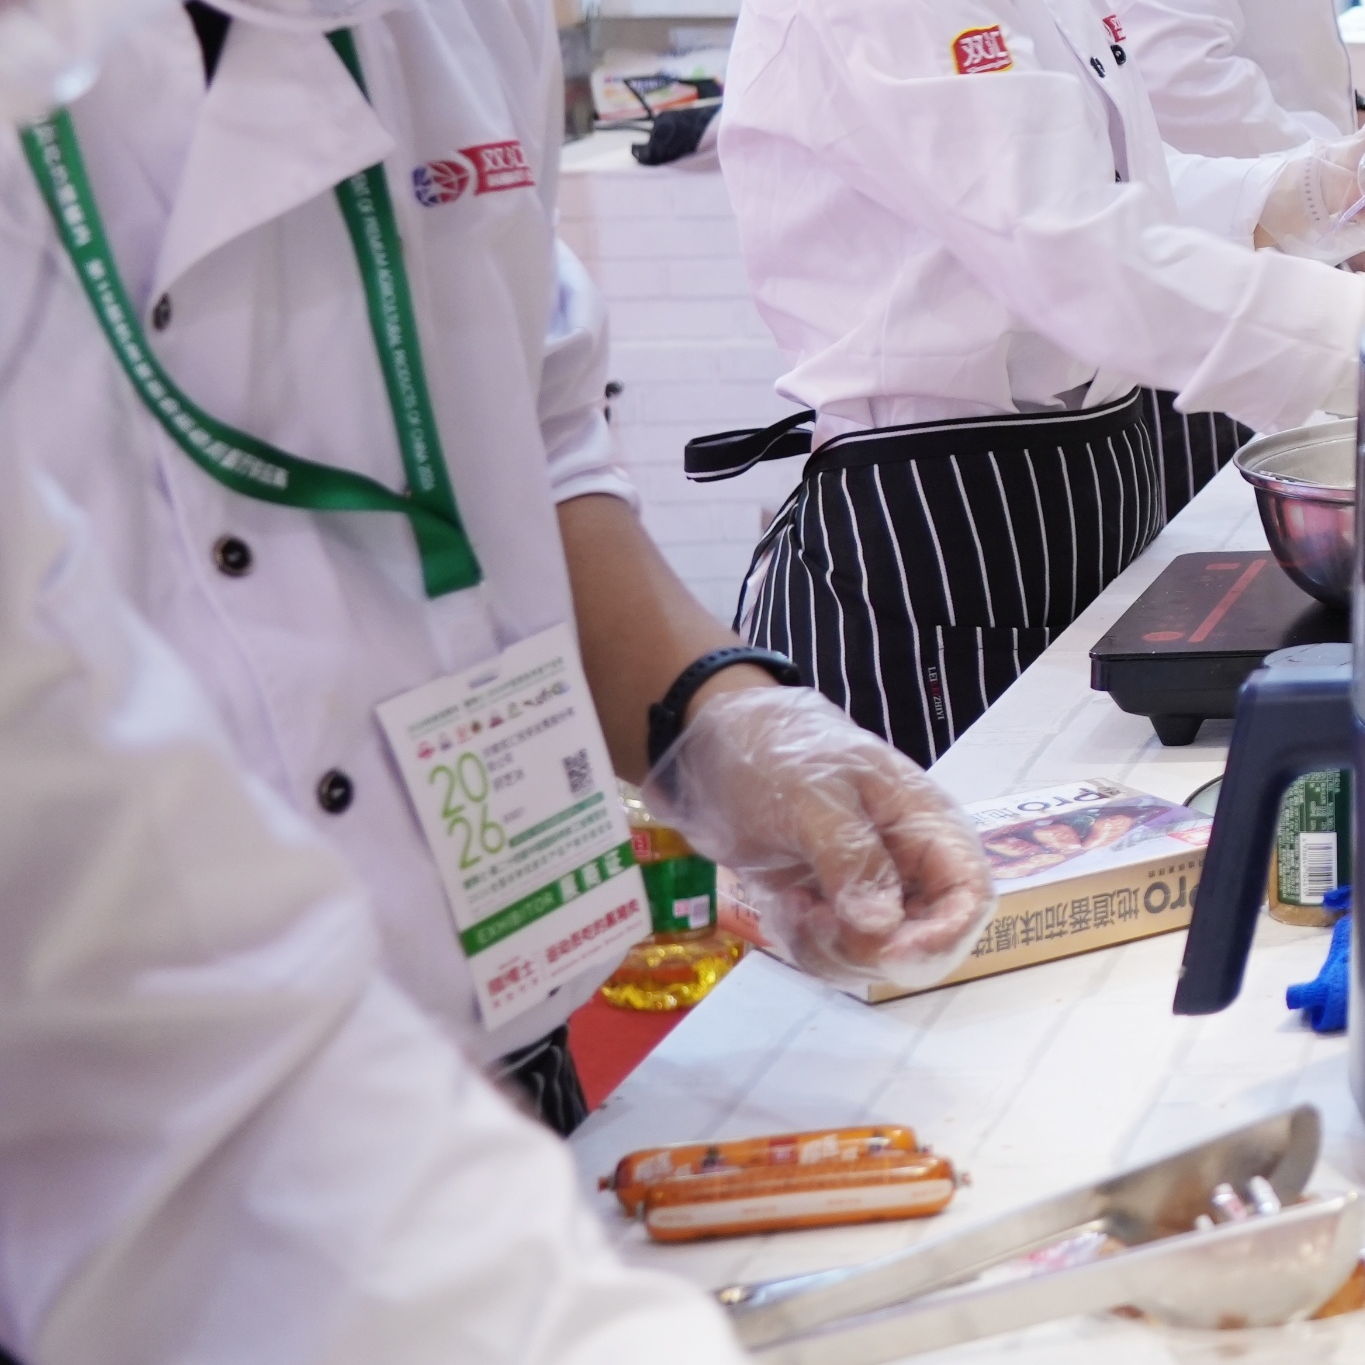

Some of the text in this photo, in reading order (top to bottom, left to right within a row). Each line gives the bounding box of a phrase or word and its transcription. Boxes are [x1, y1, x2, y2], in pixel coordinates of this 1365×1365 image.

[959, 31, 1008, 67] 双汇
[427, 750, 490, 822] 20
[444, 805, 508, 872] 26
